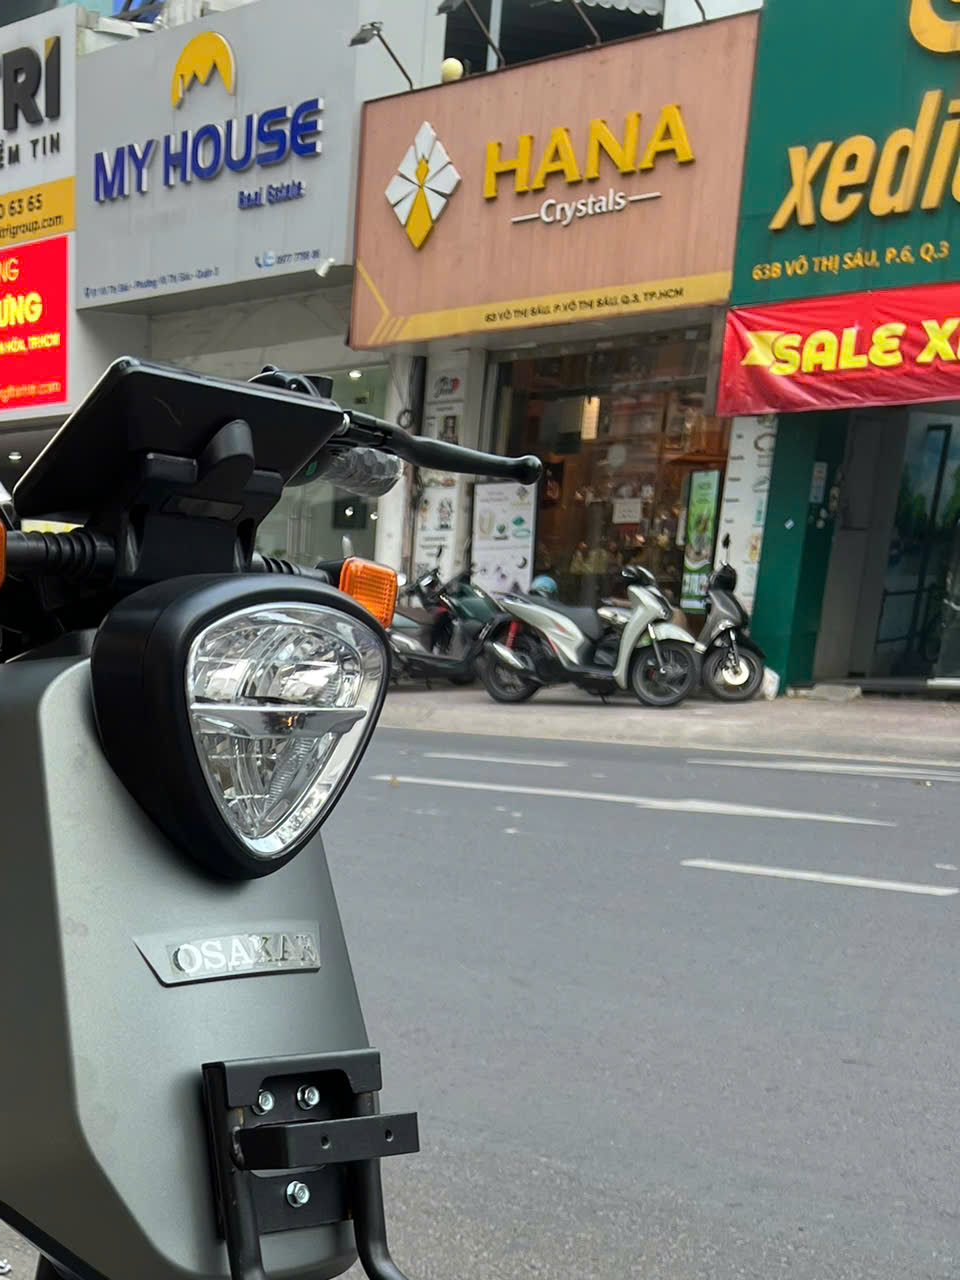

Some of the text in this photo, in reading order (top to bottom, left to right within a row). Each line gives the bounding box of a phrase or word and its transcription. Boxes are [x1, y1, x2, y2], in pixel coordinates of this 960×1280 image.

[32, 132, 62, 157] TIN
[94, 98, 325, 203] MY HOUSE
[484, 104, 696, 201] HANA
[768, 89, 960, 230] xedi
[539, 188, 627, 226] Crystals
[811, 254, 840, 275] THỊ
[919, 240, 950, 263] Q.3
[769, 317, 960, 376] SALE X
